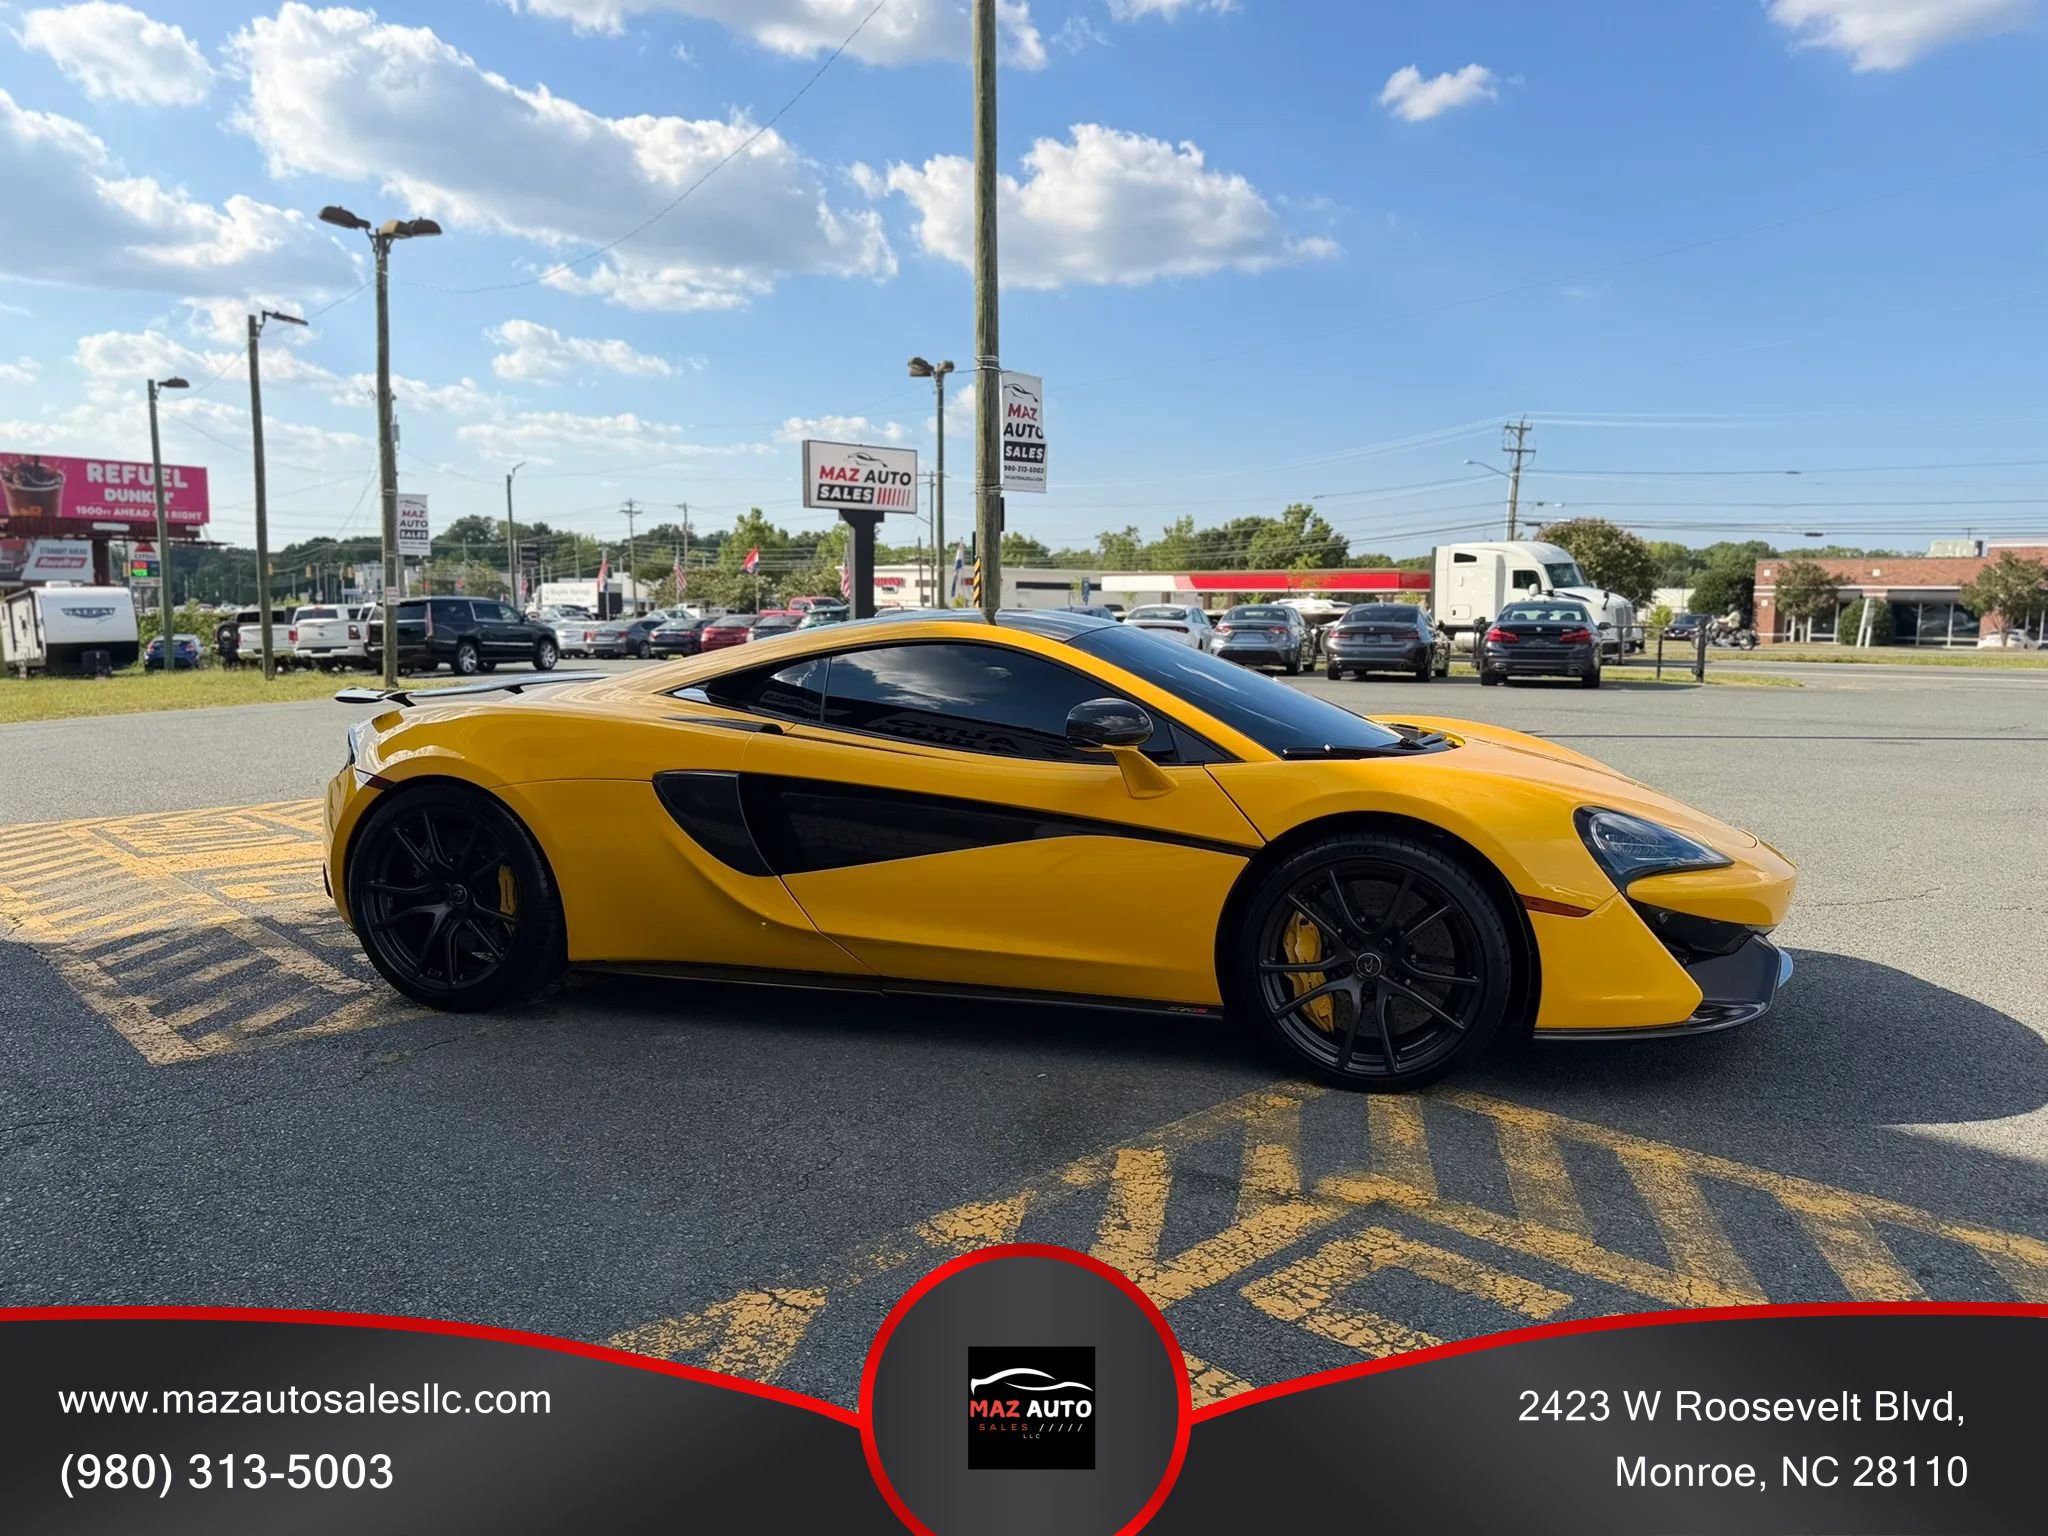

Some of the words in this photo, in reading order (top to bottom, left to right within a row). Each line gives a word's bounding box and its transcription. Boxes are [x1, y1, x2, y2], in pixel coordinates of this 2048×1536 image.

[1007, 402, 1038, 421] MAZ
[1003, 422, 1044, 439] AUTO
[1005, 445, 1044, 459] SALES
[86, 462, 188, 489] REFUEL
[819, 465, 860, 482] MAZ
[863, 469, 912, 486] AUTO
[819, 485, 873, 501] SALES
[113, 507, 150, 518] AHEAD
[171, 510, 202, 521] RIGHT
[401, 510, 425, 518] MAZ
[400, 519, 428, 528] AUTO
